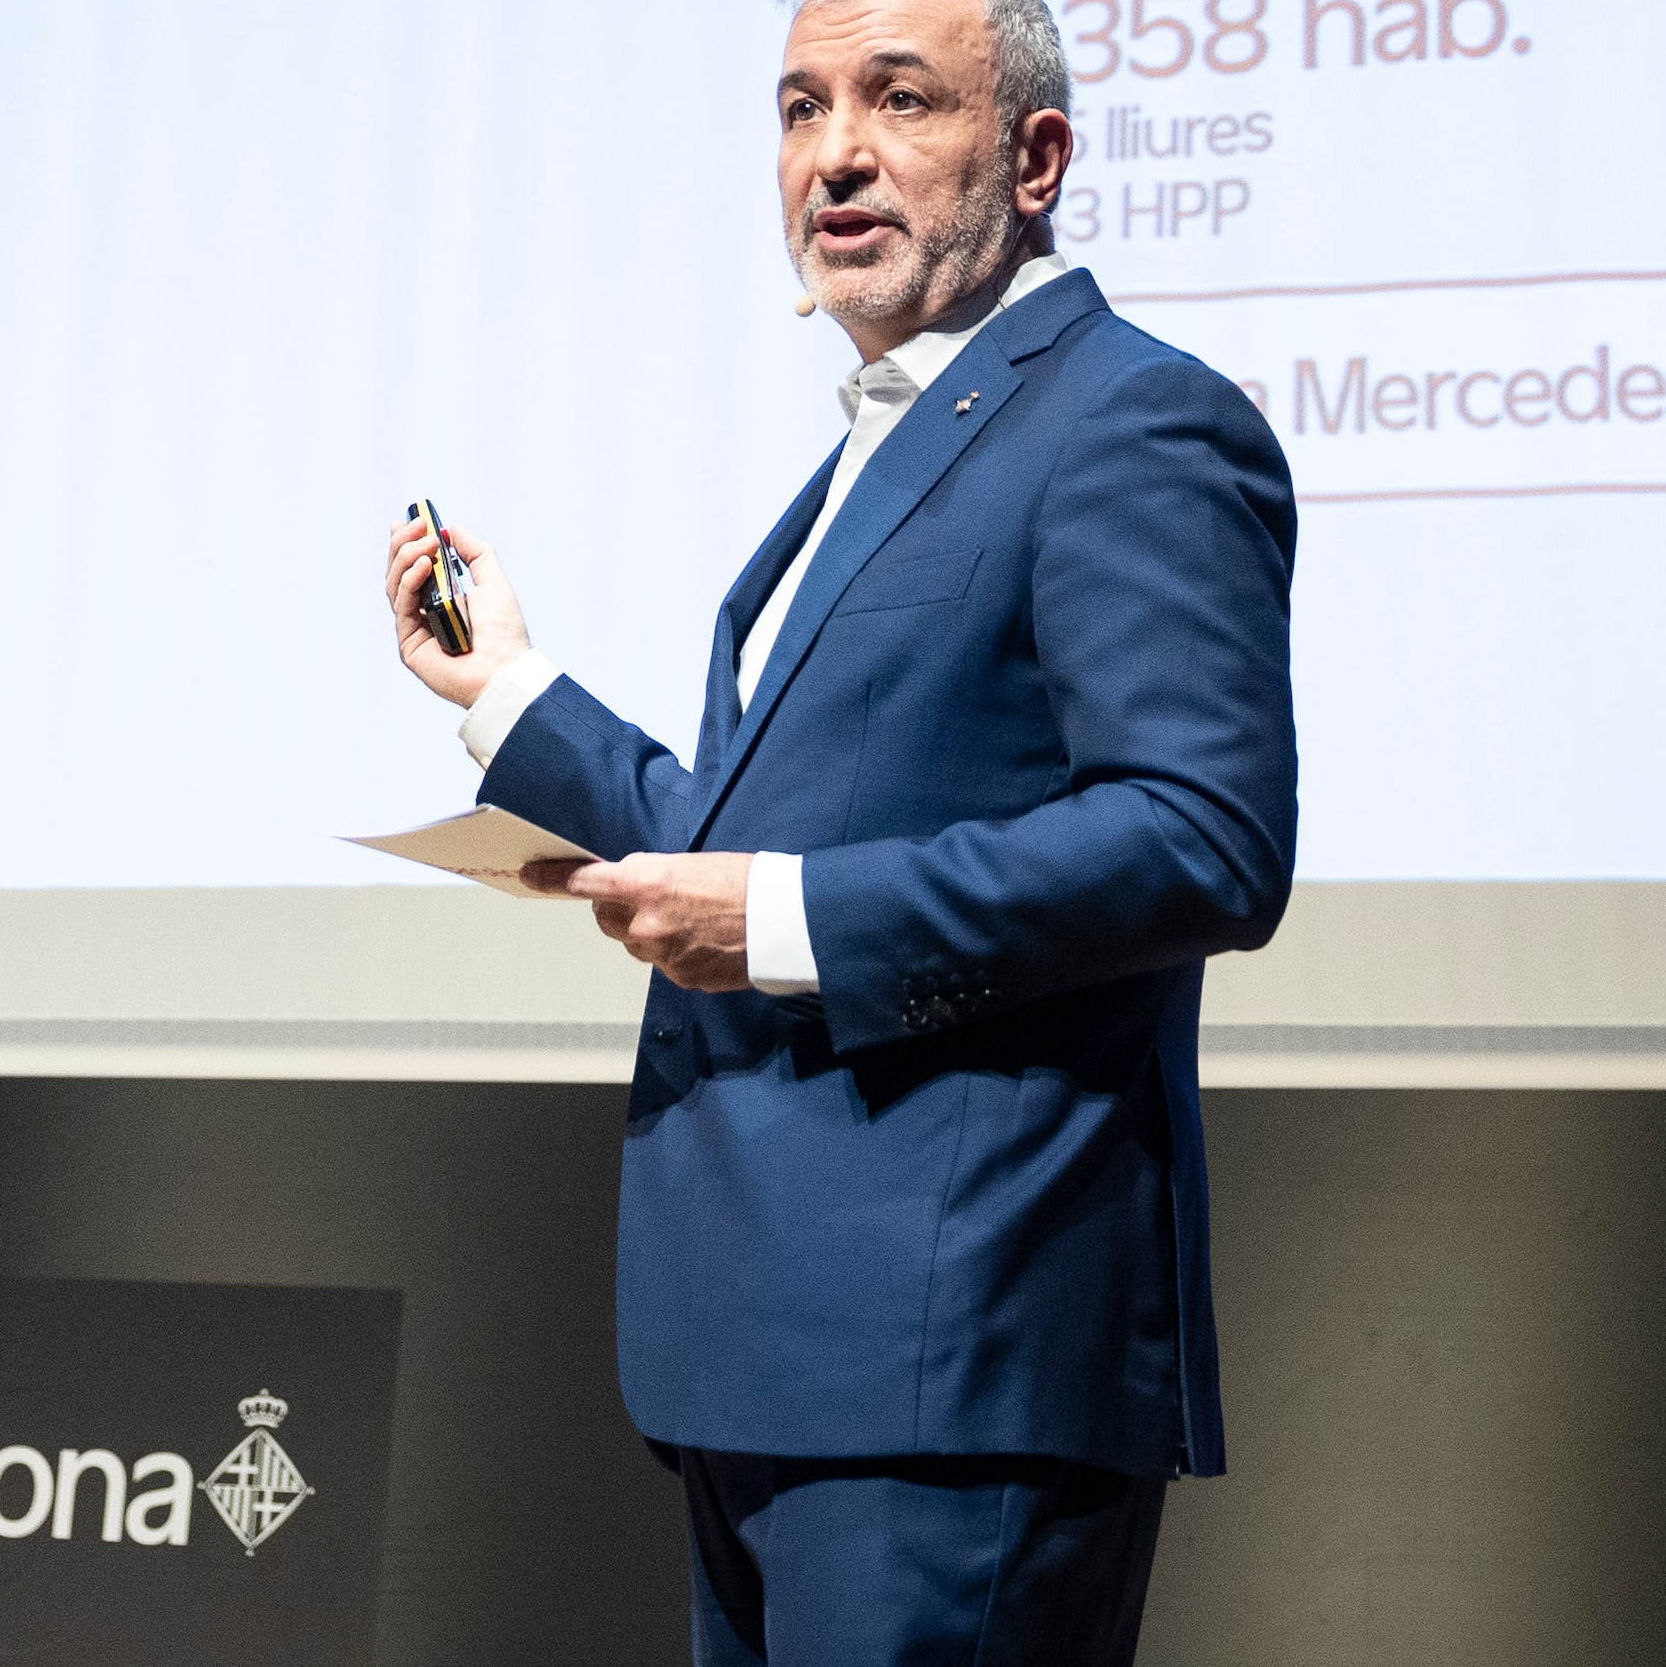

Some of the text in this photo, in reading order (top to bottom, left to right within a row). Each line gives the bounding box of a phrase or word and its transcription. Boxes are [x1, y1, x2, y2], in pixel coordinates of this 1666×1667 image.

[1107, 105, 1274, 161] lliures
[1053, 178, 1249, 243] 3 HPP
